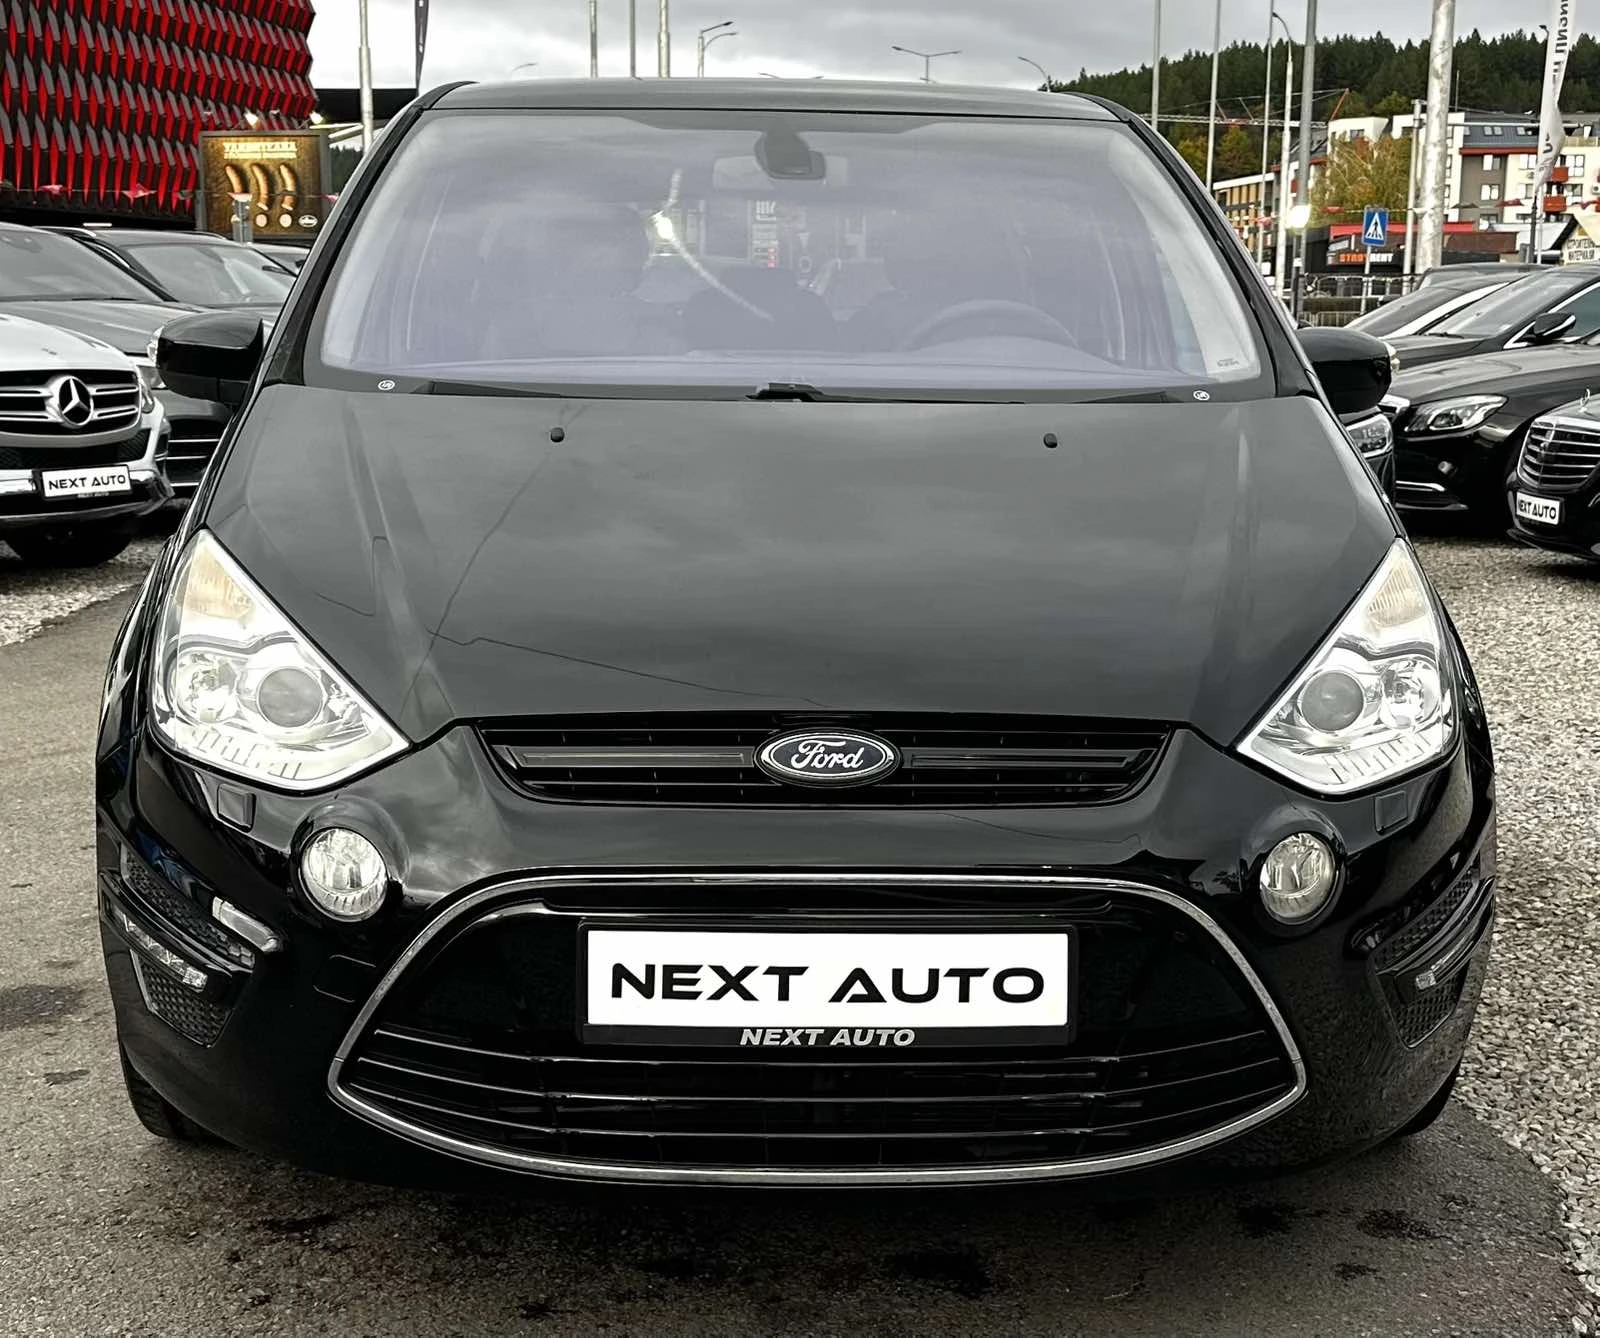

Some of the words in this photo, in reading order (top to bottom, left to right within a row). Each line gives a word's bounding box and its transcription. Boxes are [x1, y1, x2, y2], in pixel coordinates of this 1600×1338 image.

[49, 477, 87, 490] NEXT
[92, 475, 125, 486] AUTO
[1532, 503, 1556, 519] AUTO
[790, 739, 865, 769] Ford
[611, 963, 809, 1001] NEXT
[828, 967, 1044, 1003] AUTO
[739, 1029, 824, 1046] NEXT
[829, 1029, 916, 1047] AUTO
